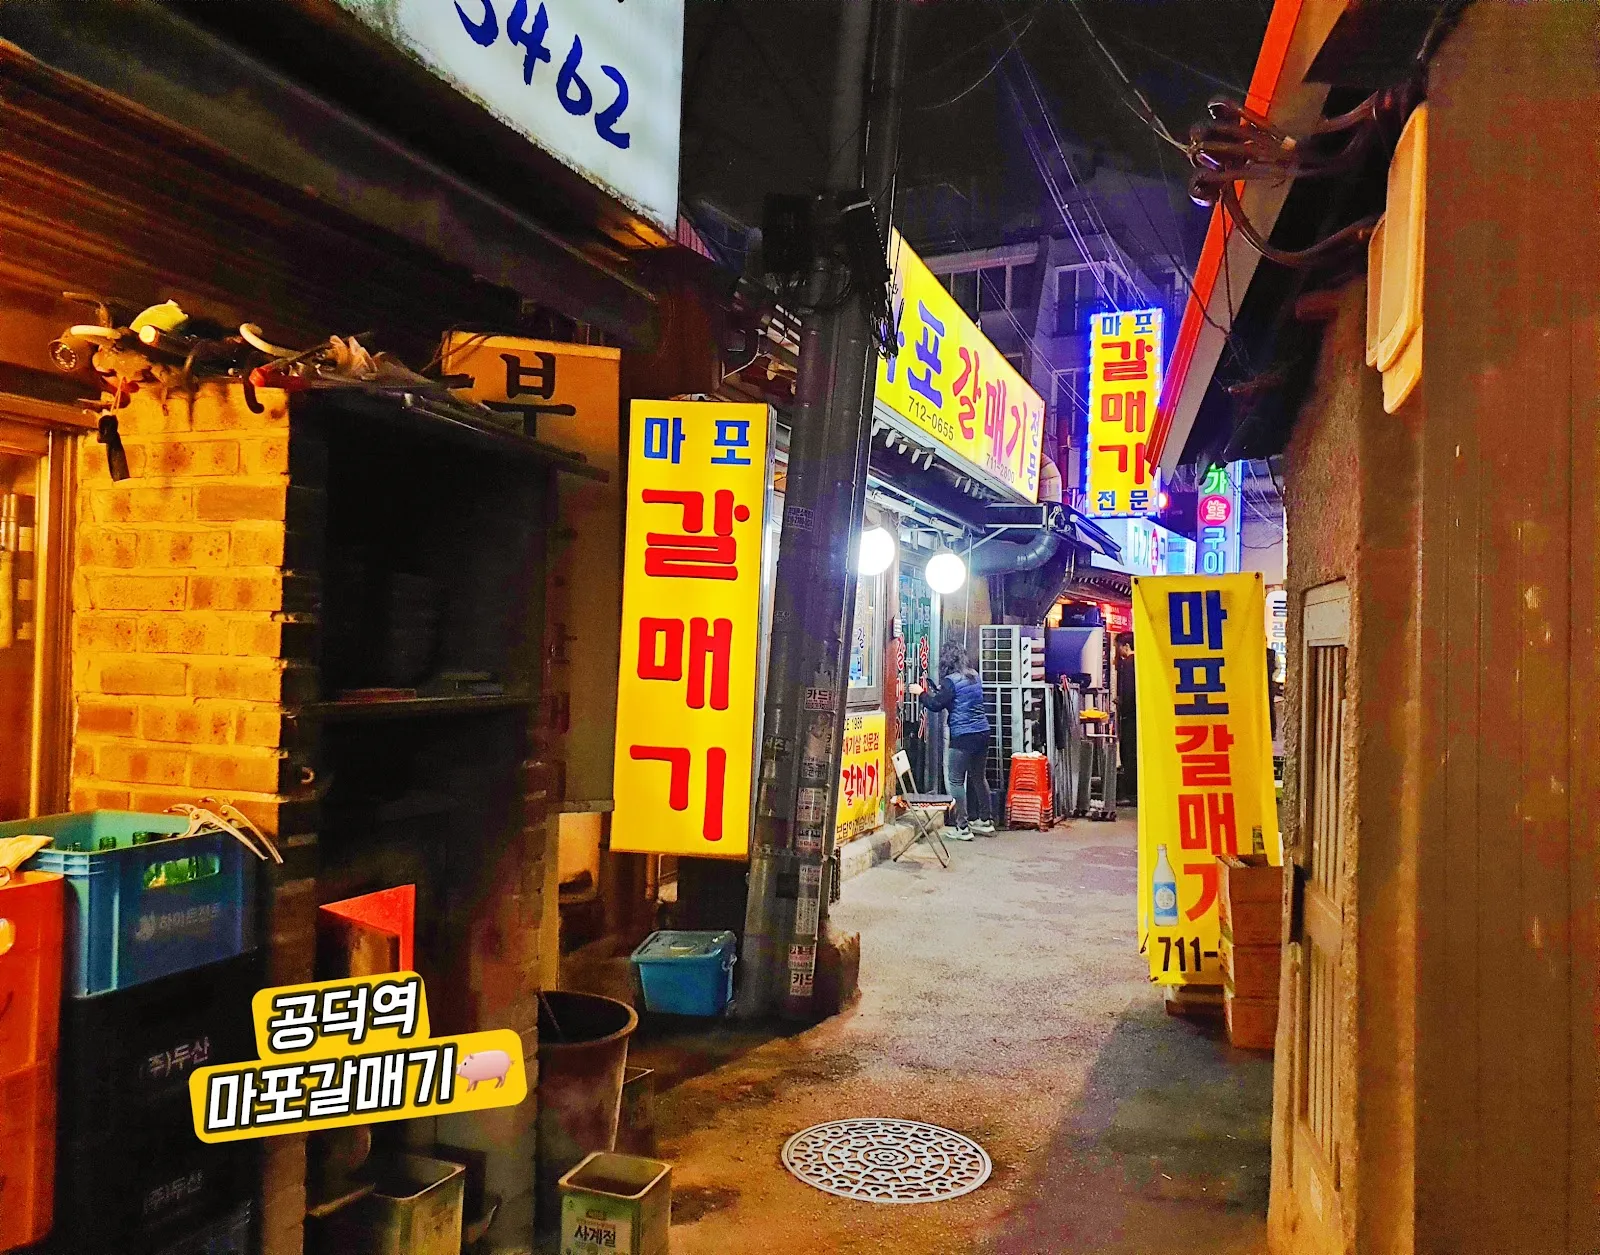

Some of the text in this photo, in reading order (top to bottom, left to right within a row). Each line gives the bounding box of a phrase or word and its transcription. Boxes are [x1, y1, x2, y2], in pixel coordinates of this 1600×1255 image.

[1102, 313, 1153, 336] 마포
[908, 395, 954, 441] 712-0655
[1099, 339, 1154, 485] 갈매기
[643, 416, 751, 465] 마포
[1097, 490, 1149, 511] 전문
[629, 488, 751, 842] 갈매기
[1168, 590, 1230, 716] 마포
[842, 759, 880, 807] 갈매기
[1157, 936, 1220, 972] 711-
[573, 1223, 617, 1249] 사계절
